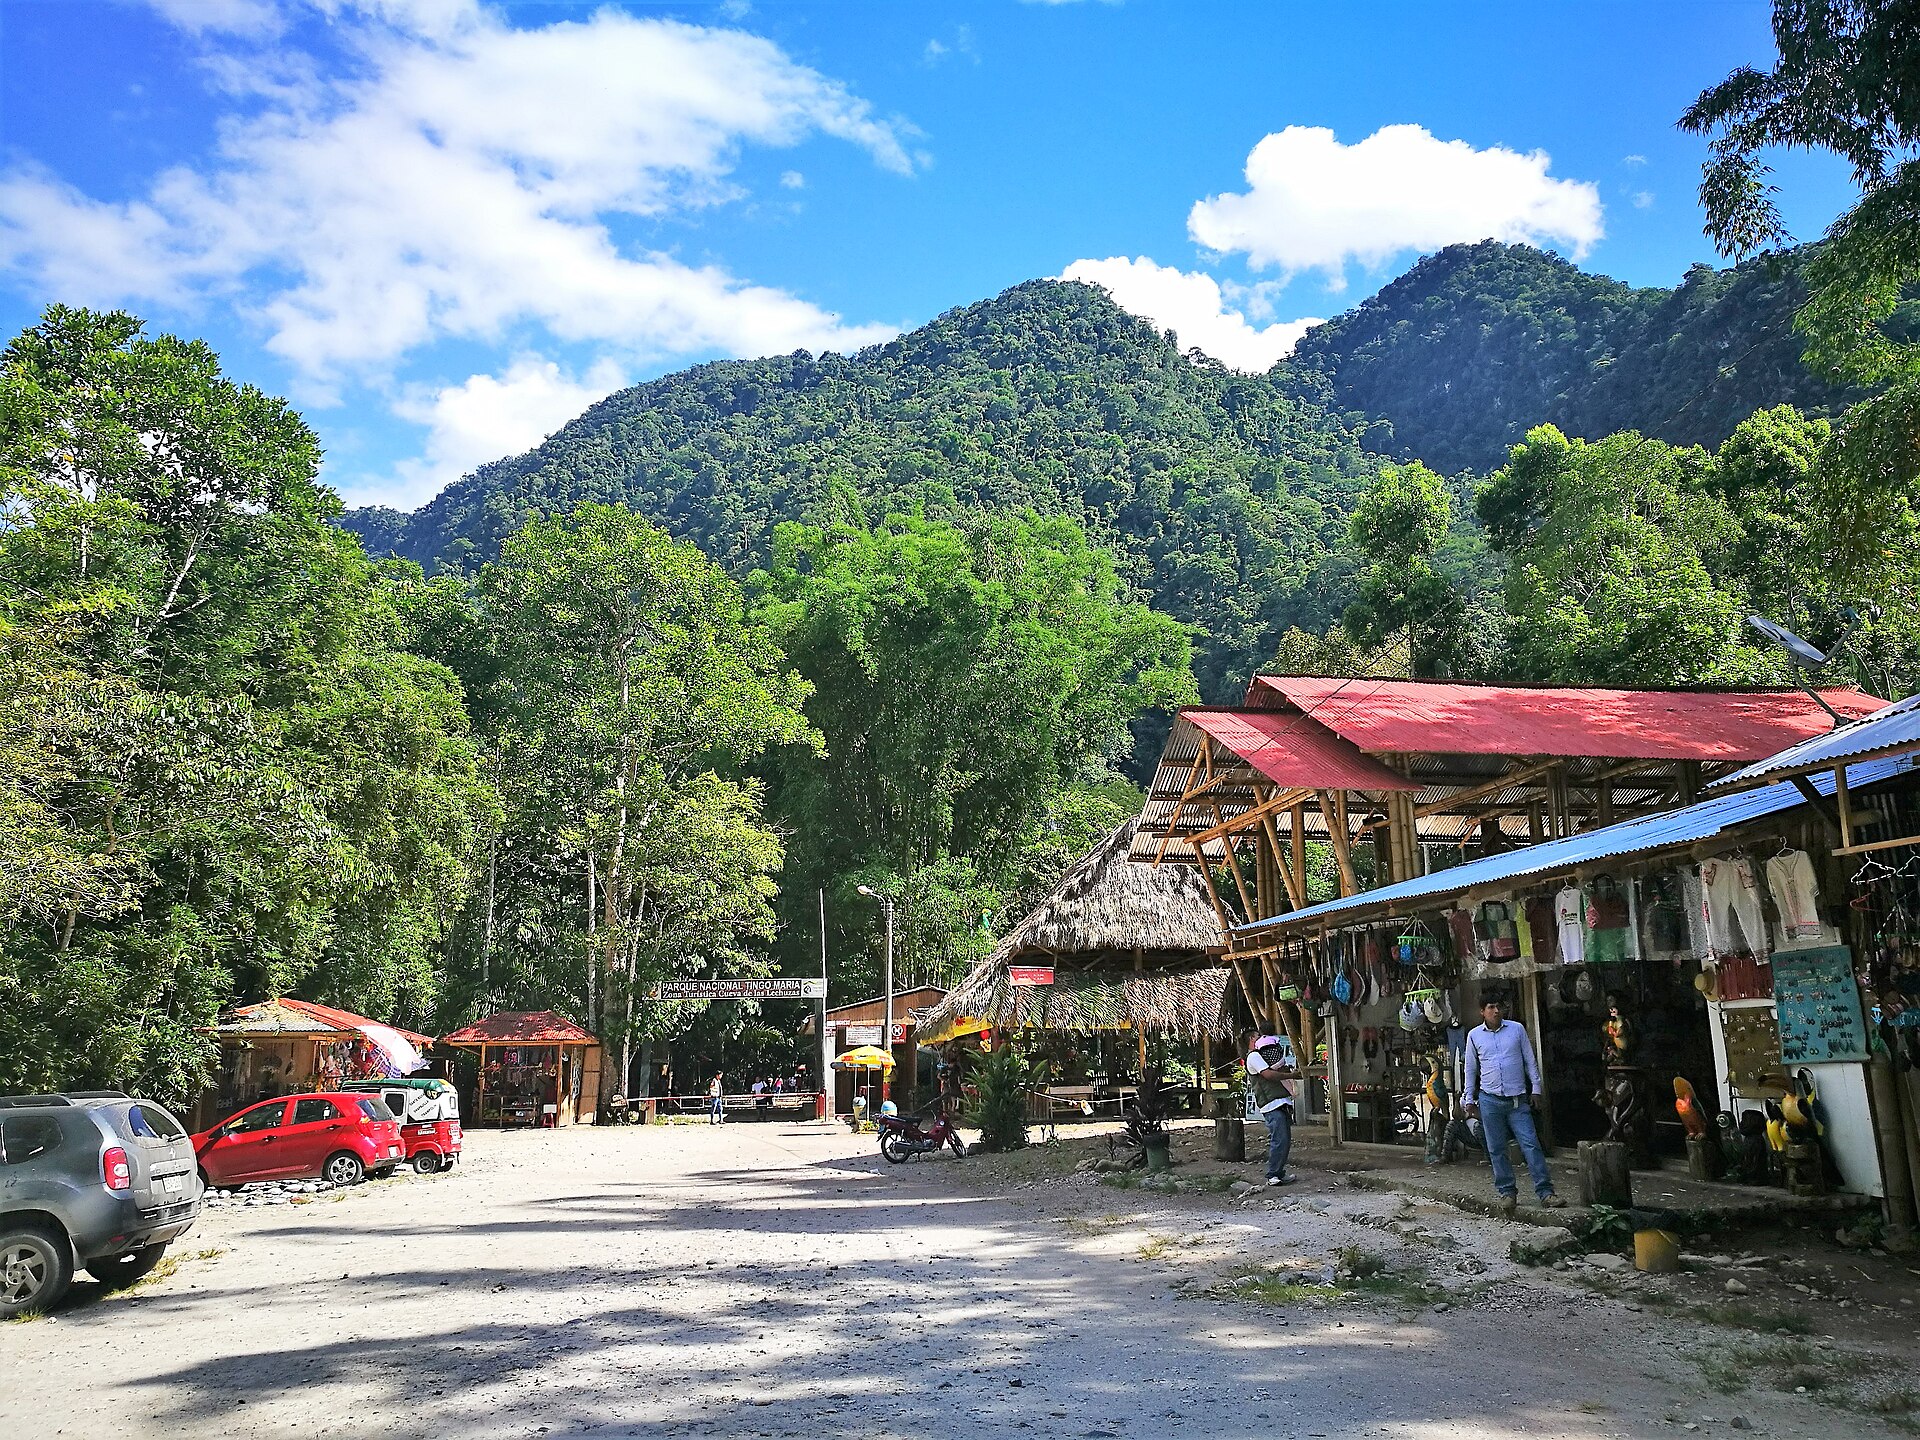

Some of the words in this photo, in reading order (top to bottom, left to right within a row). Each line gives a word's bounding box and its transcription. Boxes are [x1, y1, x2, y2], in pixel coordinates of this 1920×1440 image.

[662, 982, 698, 992] PARQUE
[699, 981, 744, 991] NACIONAL
[745, 980, 772, 990] TINGO
[773, 980, 800, 989] MARIA
[743, 989, 753, 997] de
